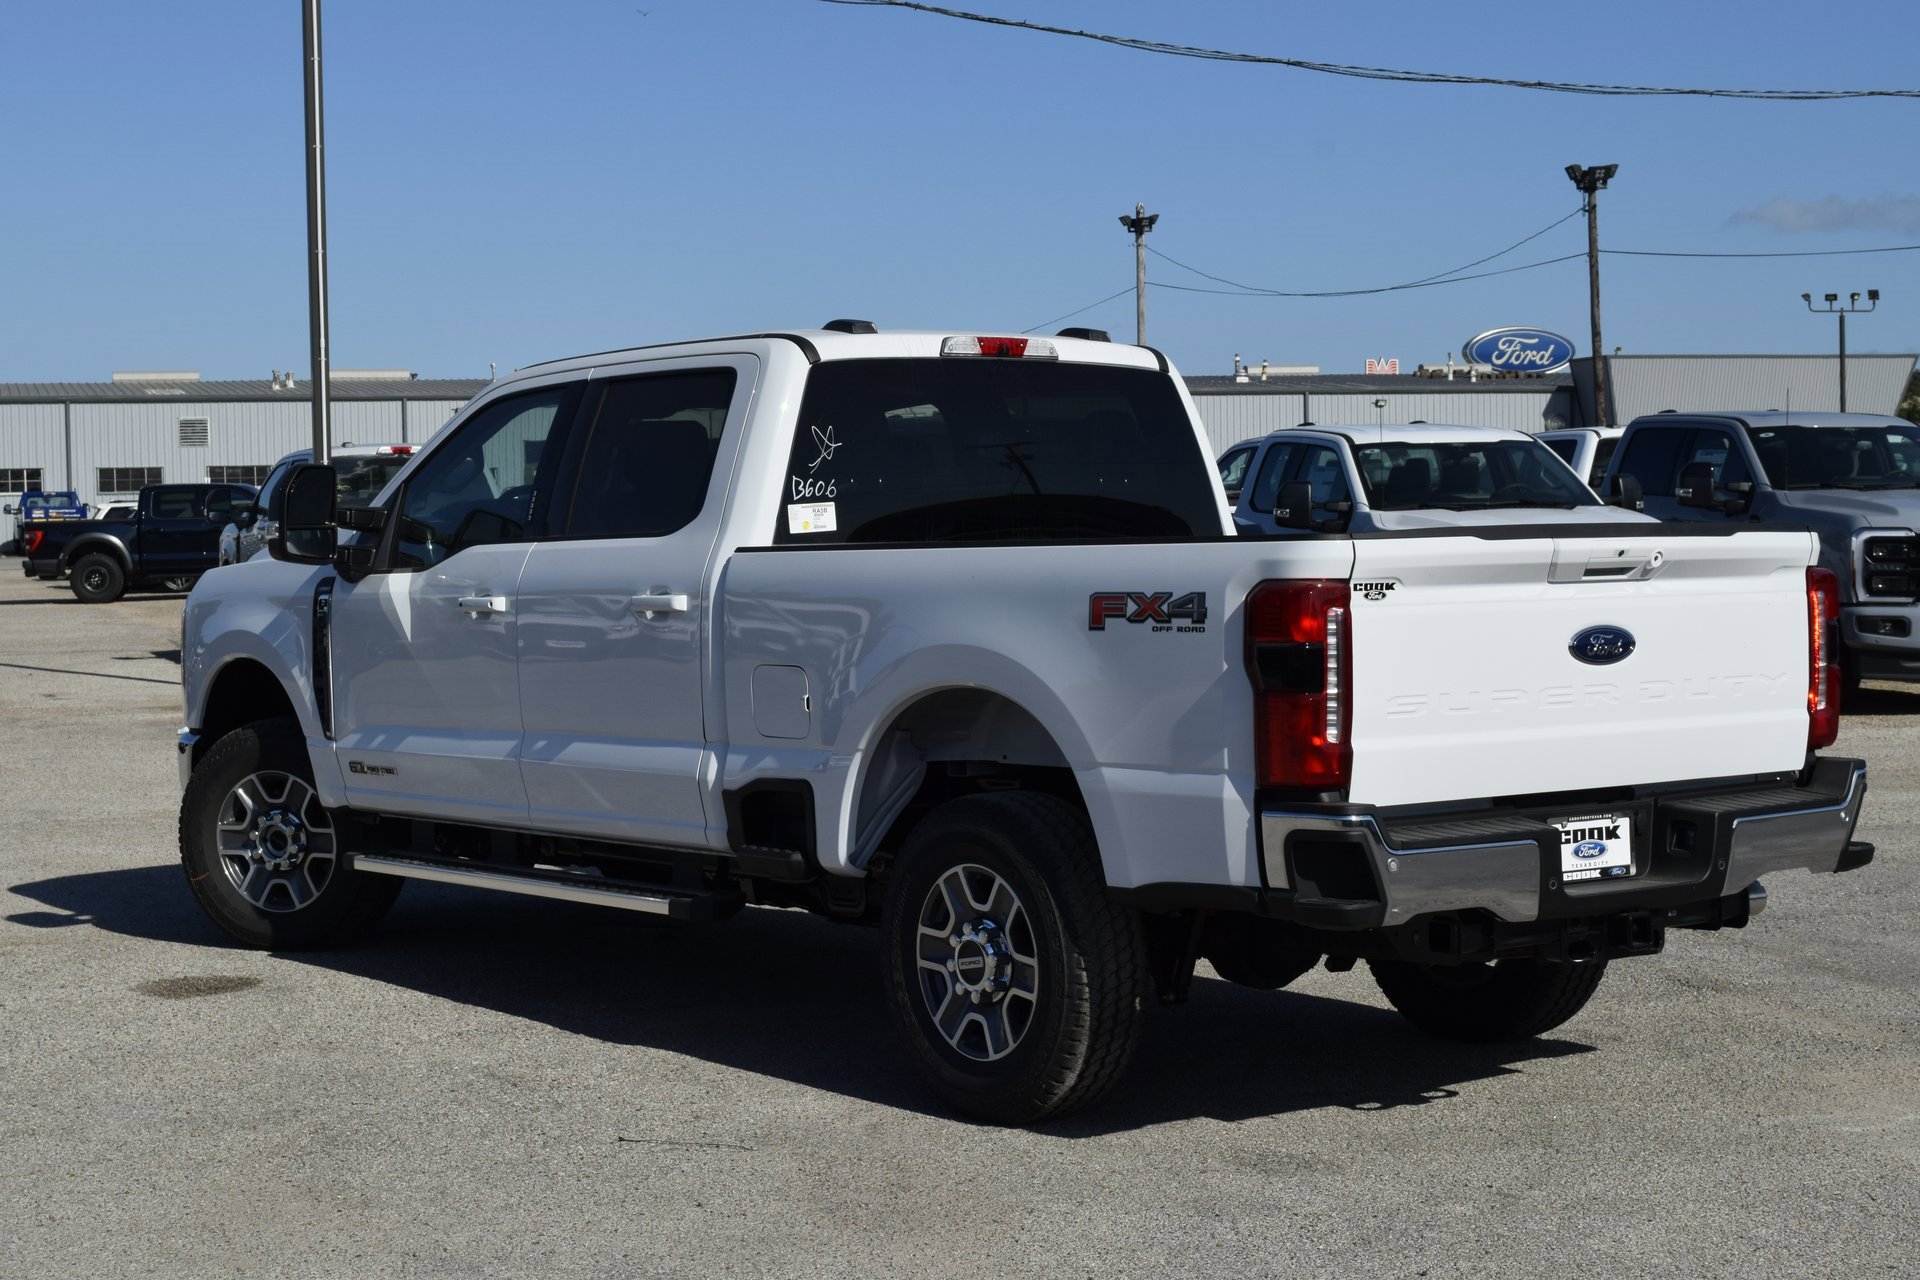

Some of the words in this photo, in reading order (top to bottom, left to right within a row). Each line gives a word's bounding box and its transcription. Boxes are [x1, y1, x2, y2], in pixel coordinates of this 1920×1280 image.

[1491, 336, 1554, 365] Ford
[792, 475, 837, 501] B606
[1353, 582, 1397, 591] COOK
[1088, 591, 1208, 631] FX4
[1586, 633, 1624, 656] Ford
[1386, 681, 1620, 720] SUPER
[1639, 672, 1789, 704] DUTY
[1560, 825, 1621, 844] COOK
[1578, 843, 1600, 857] Ford
[1563, 869, 1601, 881] COOK
[960, 959, 981, 967] FORD
